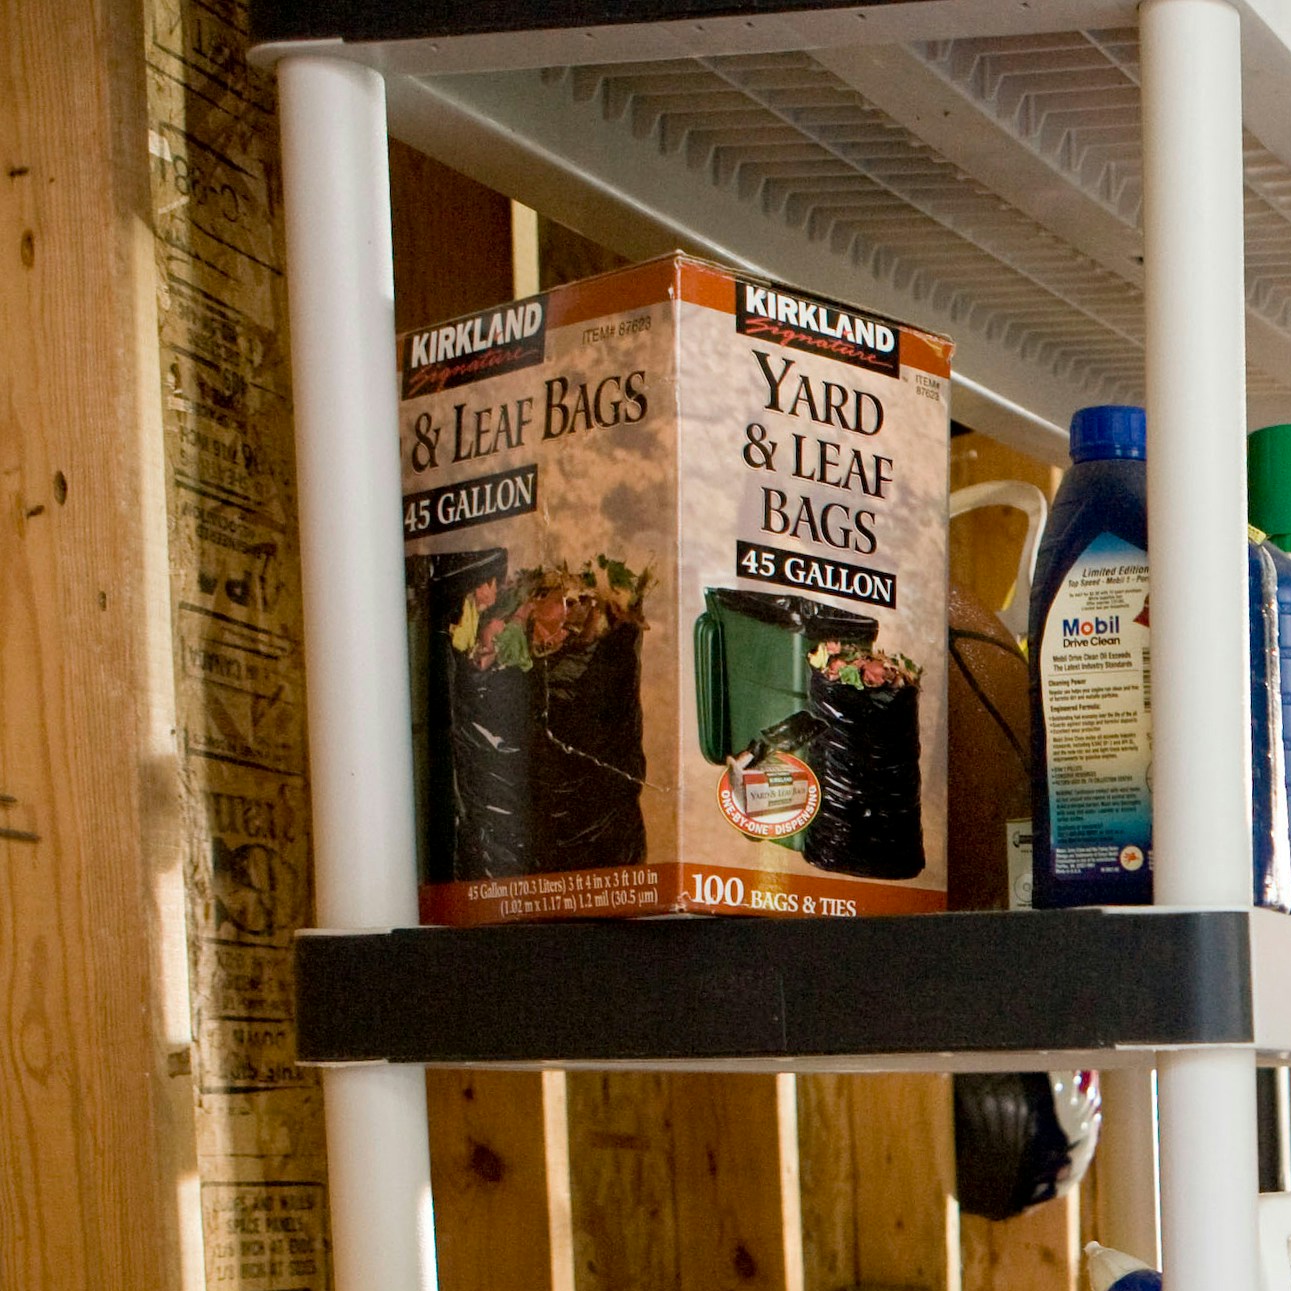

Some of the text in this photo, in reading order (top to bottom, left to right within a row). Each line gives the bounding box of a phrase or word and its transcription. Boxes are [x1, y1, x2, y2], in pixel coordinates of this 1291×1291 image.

[411, 302, 542, 368] KIRKLAND
[583, 325, 615, 344] ITEM#
[746, 285, 896, 354] KIRKLAND
[746, 316, 894, 369] Signature
[409, 346, 535, 398] Signature
[751, 349, 884, 437] YARD
[412, 370, 648, 474] & LEAF BAGS
[742, 422, 894, 499] & LEAF
[404, 473, 534, 532] 45 GALLON
[760, 486, 878, 555] BAGS
[741, 550, 893, 603] 45 GALLON
[1082, 567, 1116, 577] Limited
[1063, 615, 1119, 637] Mobil
[1063, 636, 1120, 648] Drive Clean
[1082, 662, 1103, 670] Industry
[775, 784, 818, 835] DISPENSING
[480, 882, 508, 899] Gallon
[509, 880, 537, 899] (170.3
[539, 878, 566, 894] Liters)
[568, 877, 574, 891] 3
[576, 876, 583, 890] ft
[585, 875, 591, 889] 4
[593, 874, 603, 889] in
[604, 877, 611, 888] x
[613, 873, 619, 887] 3
[621, 871, 629, 886] ft
[632, 870, 645, 885] 10
[647, 869, 658, 884] in
[500, 898, 523, 917] (1.02
[543, 896, 561, 911] 1.17
[563, 894, 577, 913] m)
[579, 892, 592, 908] 1.2
[594, 890, 609, 907] mil
[610, 889, 636, 908] (30.5
[691, 873, 857, 917] 100 BAGS & TIES
